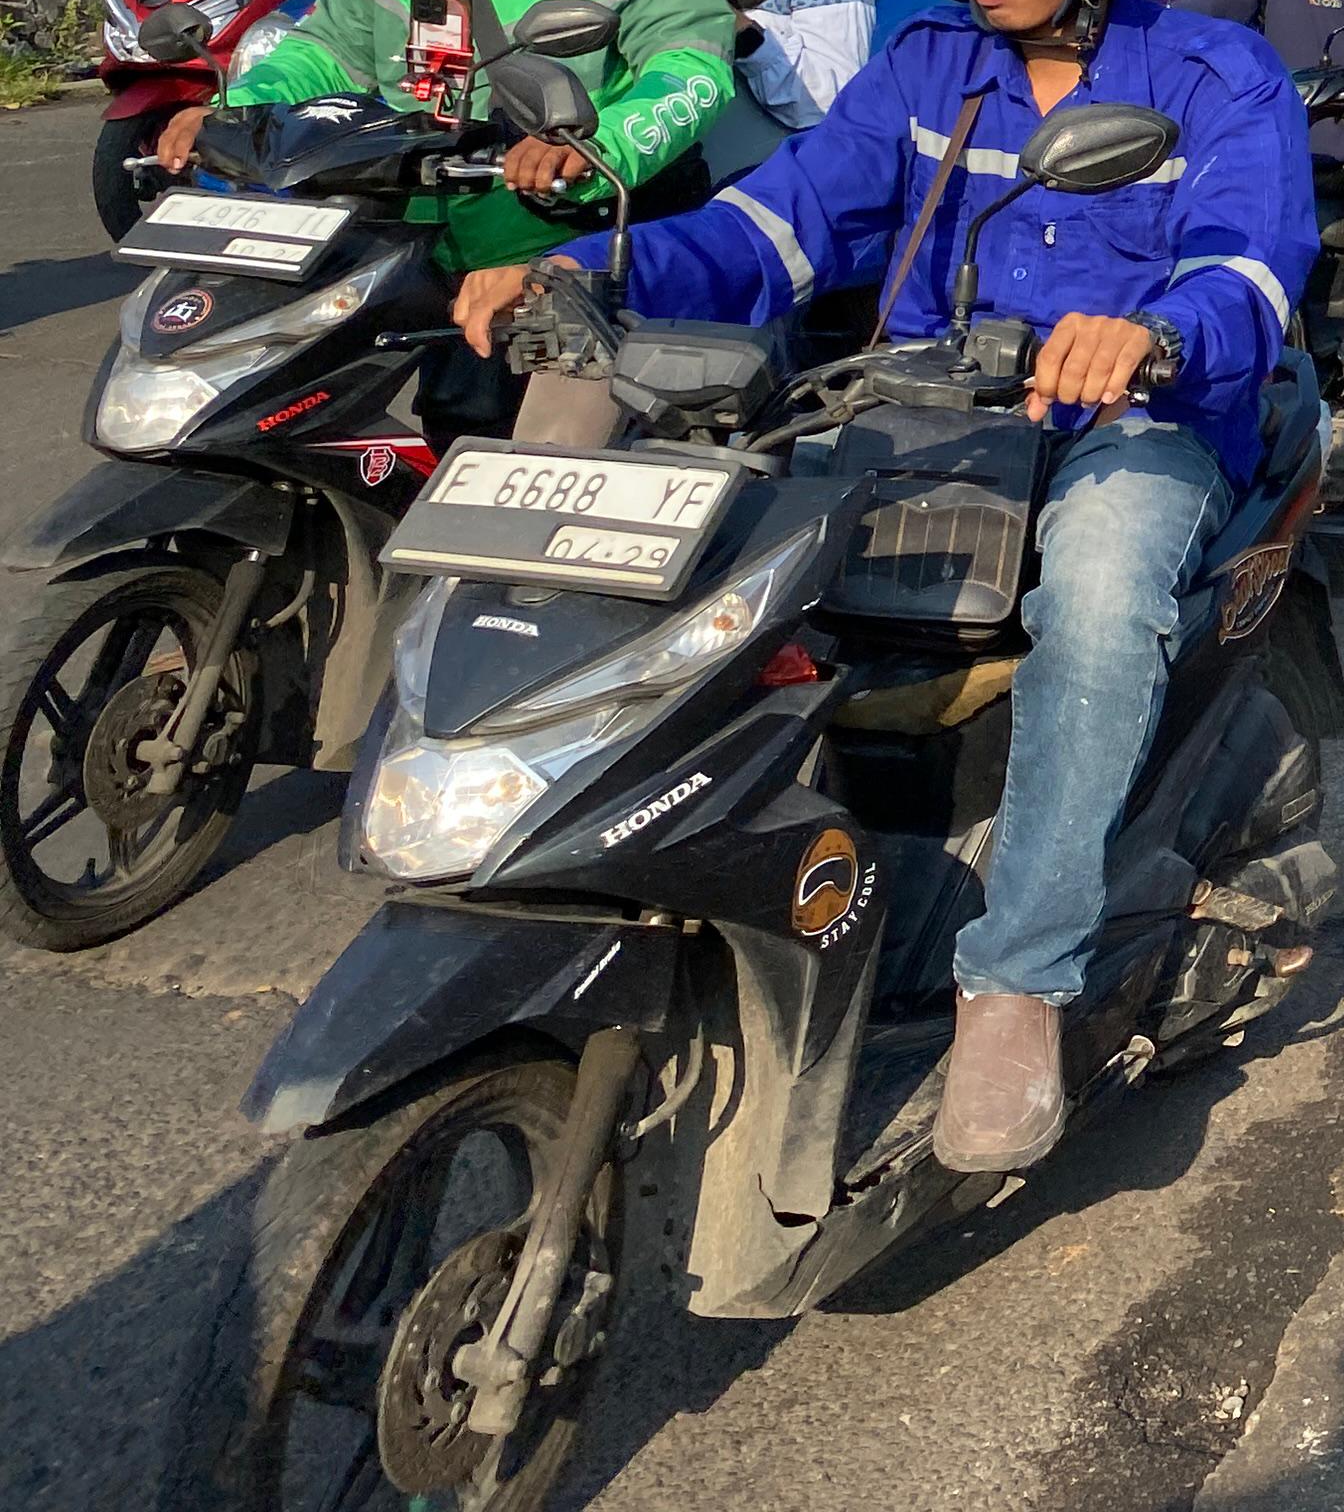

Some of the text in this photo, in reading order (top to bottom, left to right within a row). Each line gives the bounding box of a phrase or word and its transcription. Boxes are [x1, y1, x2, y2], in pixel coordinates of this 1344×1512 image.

[623, 75, 718, 155] Grab
[192, 202, 267, 230] 4976
[256, 390, 332, 433] HONDA
[438, 463, 714, 522] F 6688 YF
[472, 614, 540, 638] HONDA
[600, 771, 713, 849] HONDA
[820, 861, 877, 950] STAY COOL
